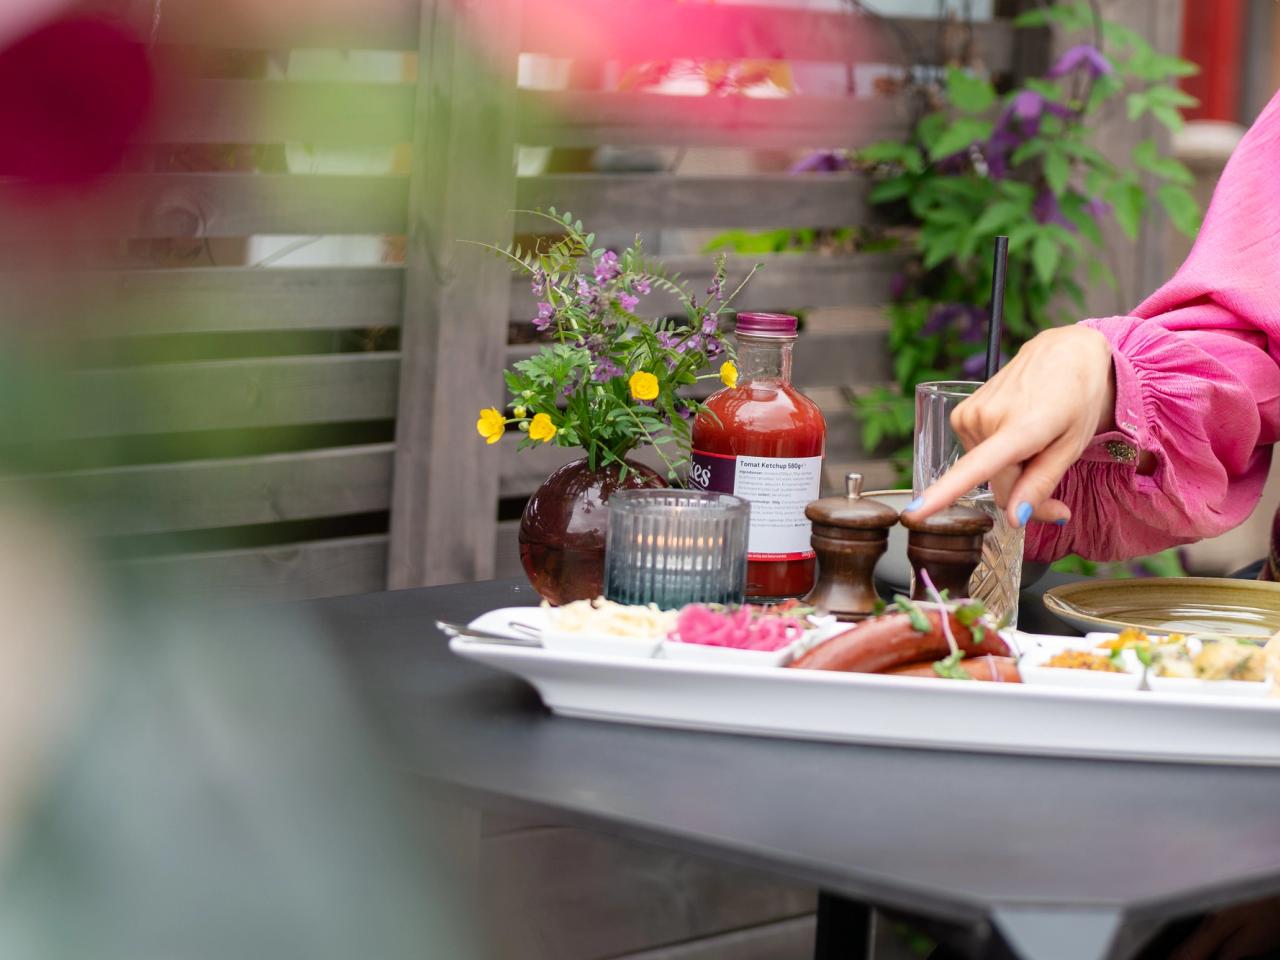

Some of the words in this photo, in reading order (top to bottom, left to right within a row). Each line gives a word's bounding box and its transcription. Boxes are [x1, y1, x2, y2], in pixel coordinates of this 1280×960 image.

[688, 454, 712, 487] kes
[740, 460, 760, 468] Tomat
[761, 462, 787, 470] Ketchup
